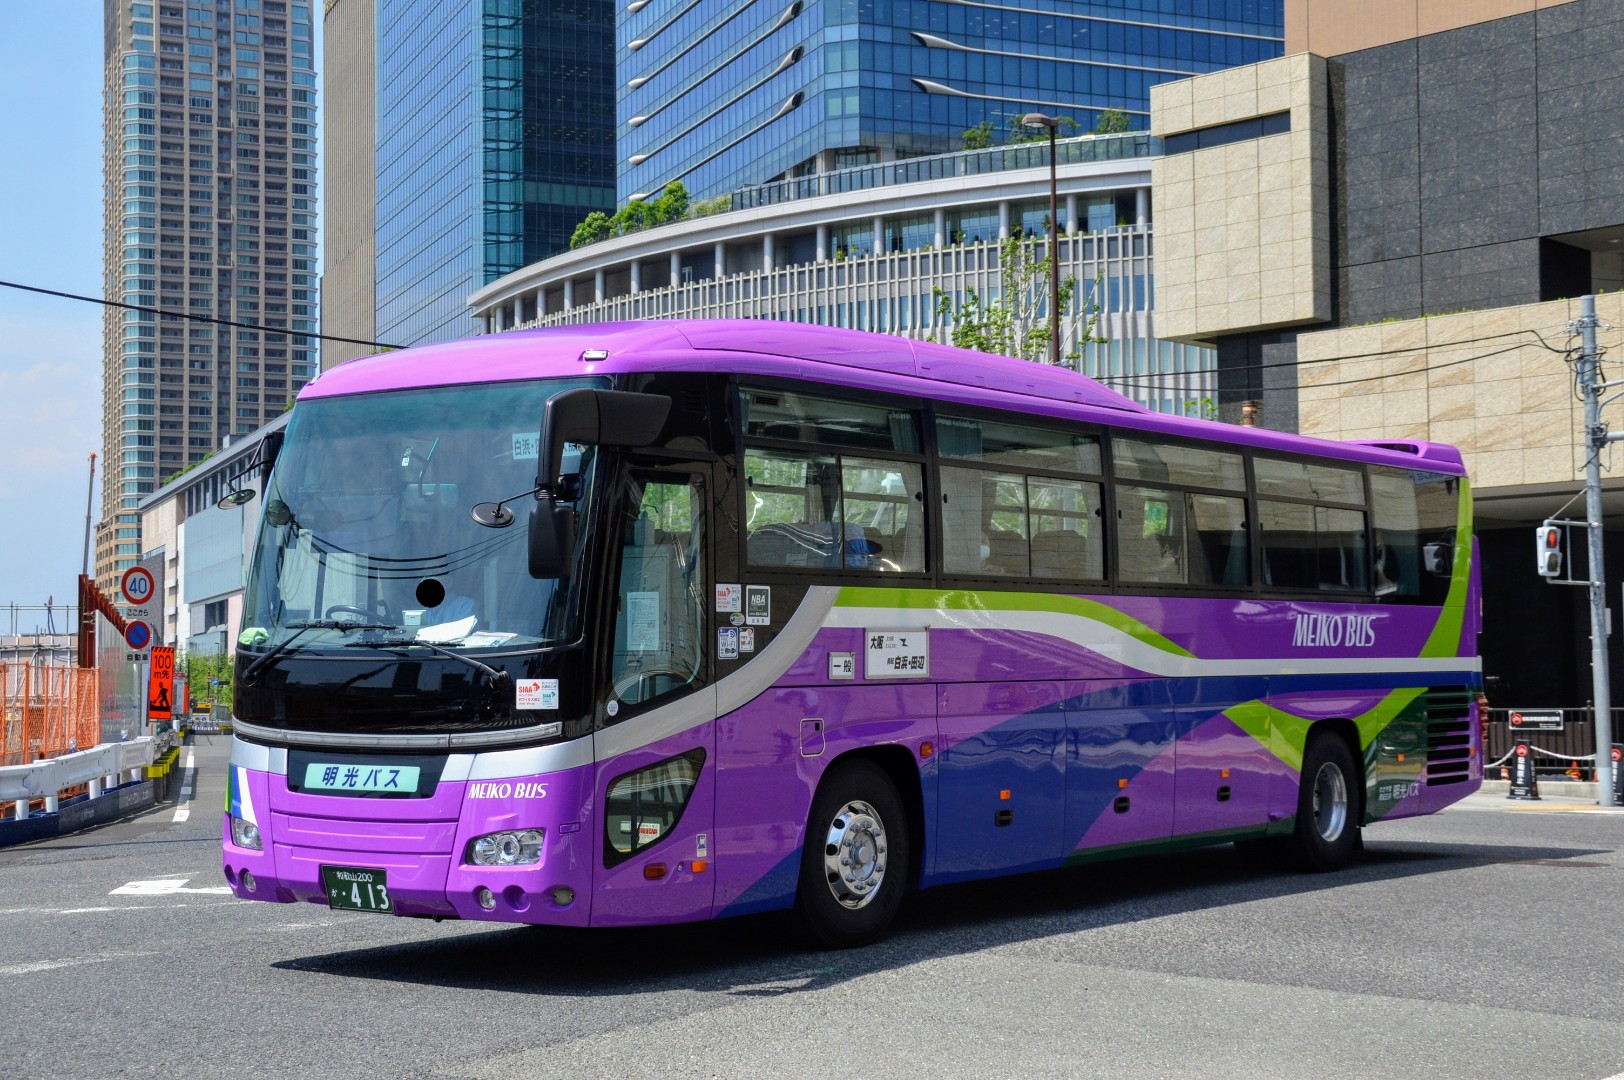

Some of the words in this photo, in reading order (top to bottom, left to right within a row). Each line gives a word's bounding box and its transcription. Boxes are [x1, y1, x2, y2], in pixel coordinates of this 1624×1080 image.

[128, 577, 148, 595] 40
[750, 594, 766, 605] NBA
[127, 608, 149, 617] ここから
[1292, 614, 1343, 647] MEIKO
[1344, 614, 1377, 647] BUS
[870, 635, 885, 650] 大阪
[126, 653, 149, 662] 自動車
[153, 655, 172, 669] 100
[833, 659, 852, 673] 一般
[518, 686, 533, 694] SIAA
[321, 766, 401, 789] 明光バス
[467, 783, 512, 799] MEIKO
[513, 783, 549, 799] BUS
[1393, 783, 1420, 800] 明光バス
